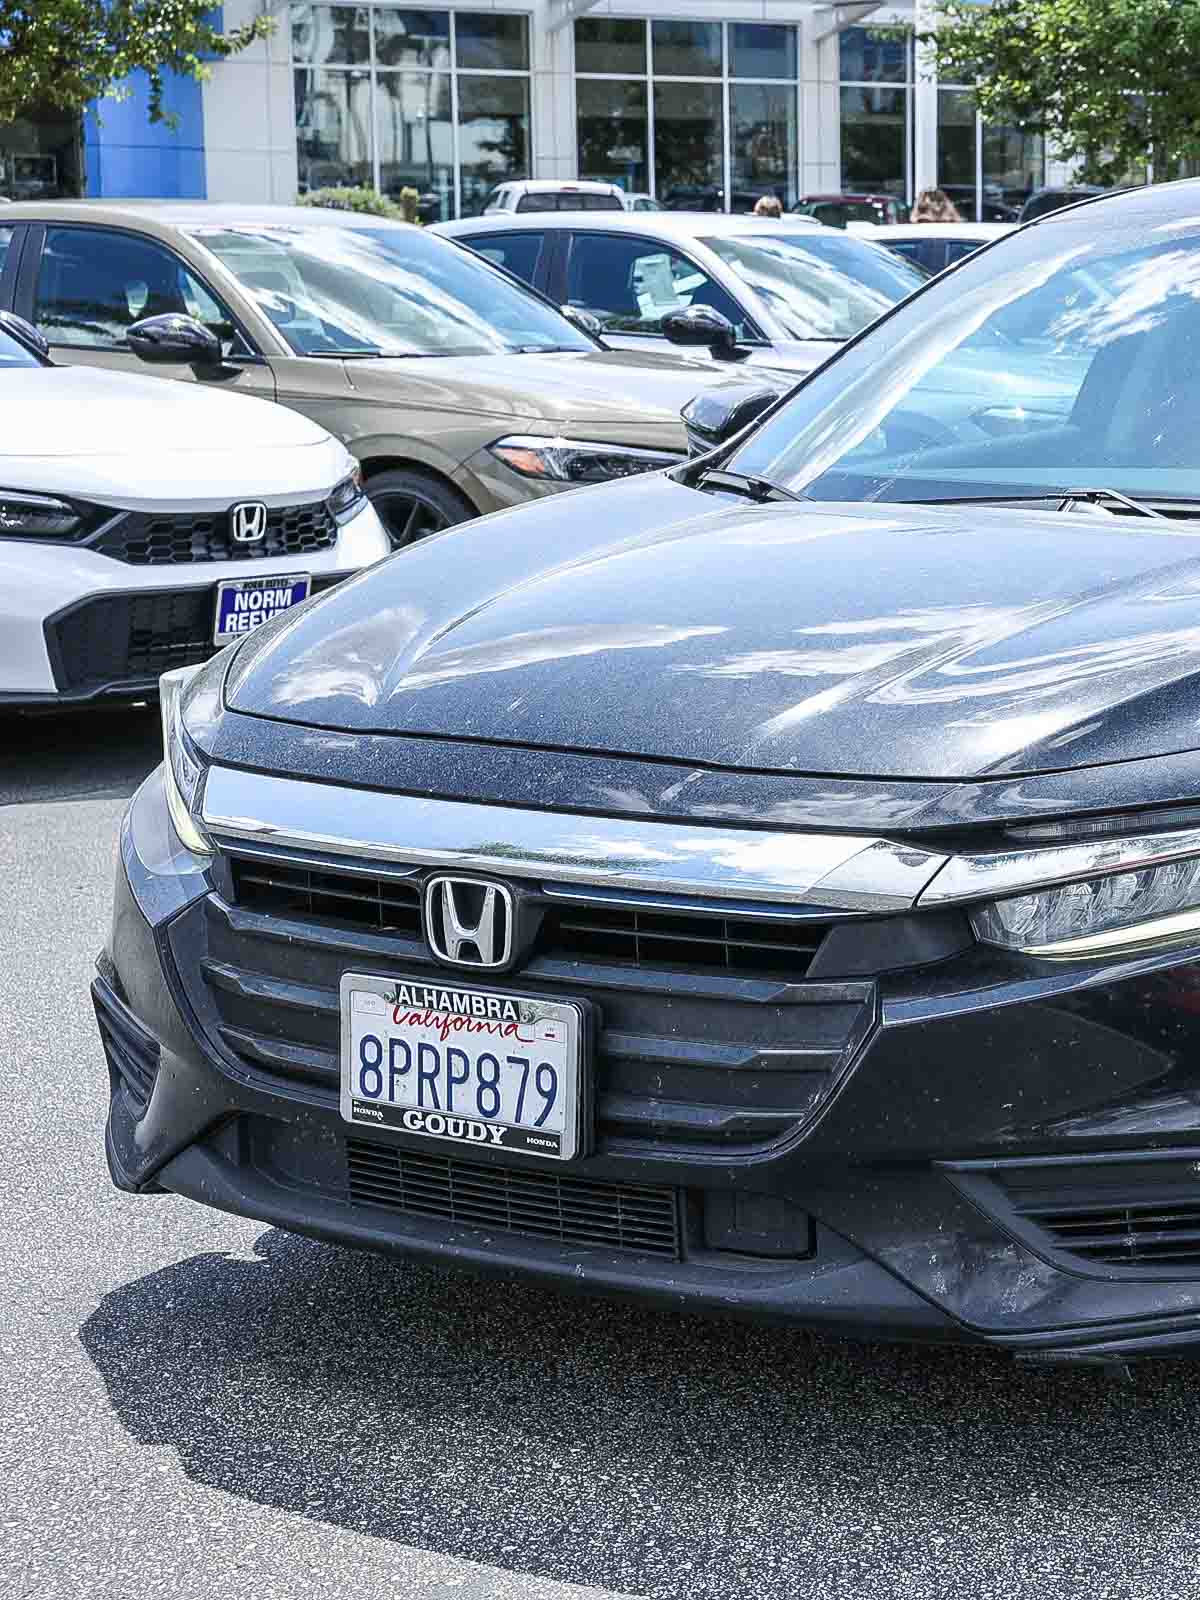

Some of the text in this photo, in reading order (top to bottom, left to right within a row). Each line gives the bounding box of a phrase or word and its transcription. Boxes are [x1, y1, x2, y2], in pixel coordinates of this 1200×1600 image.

[234, 588, 293, 612] NORM
[398, 985, 518, 1021] ALHAMBRA
[392, 1004, 535, 1042] California
[359, 1033, 559, 1127] 8PRP879
[402, 1110, 509, 1145] GOUDY
[526, 1136, 558, 1149] HONDA
